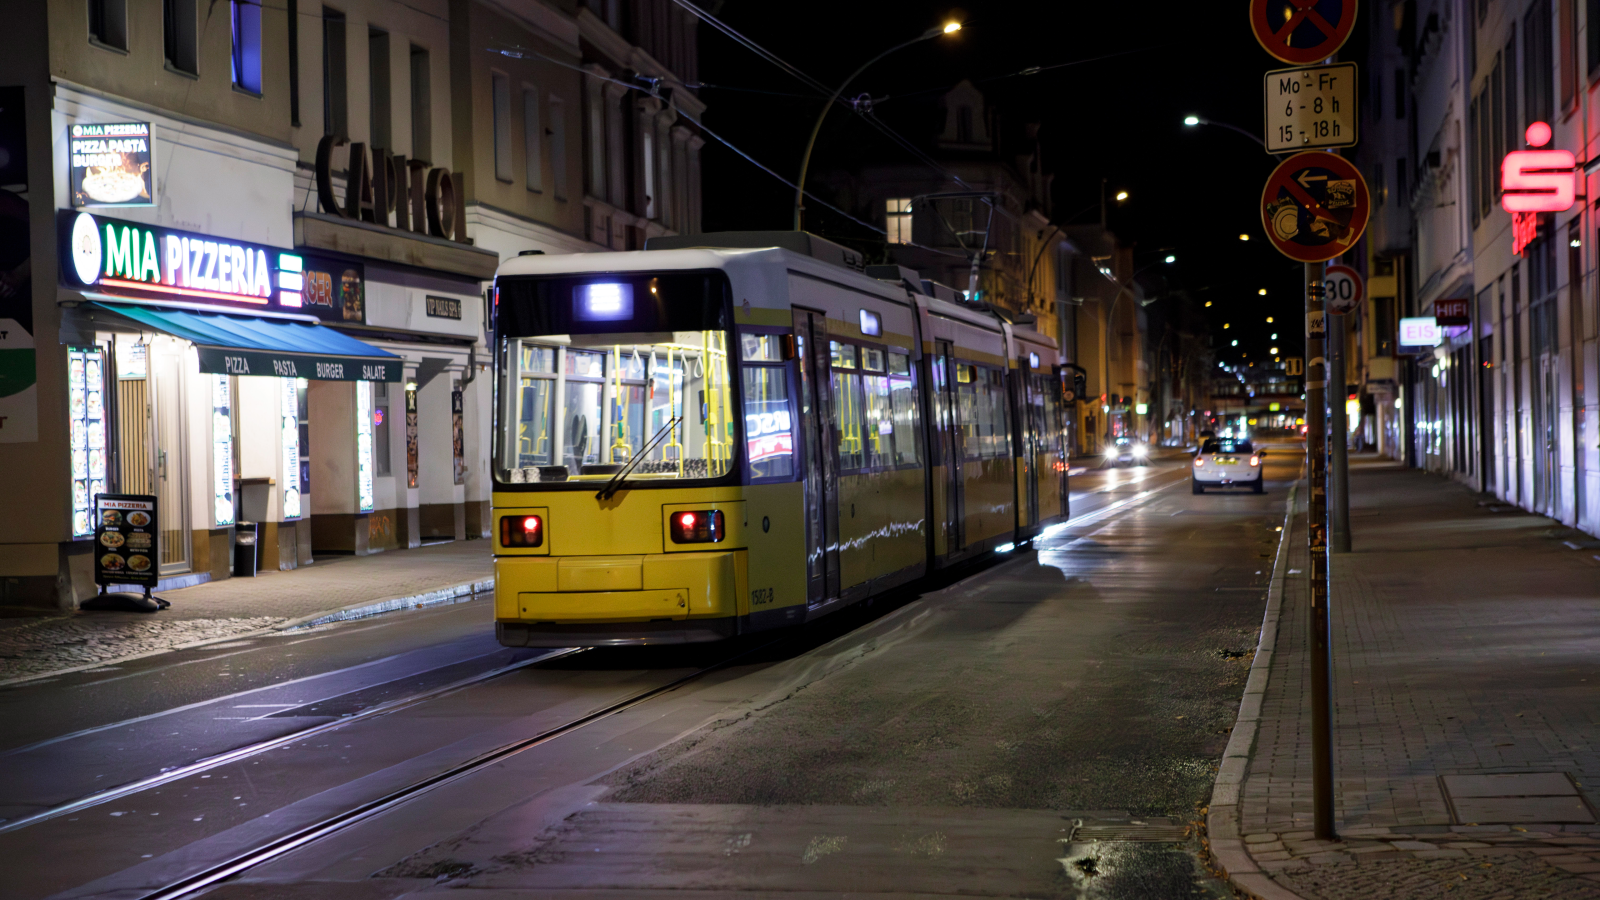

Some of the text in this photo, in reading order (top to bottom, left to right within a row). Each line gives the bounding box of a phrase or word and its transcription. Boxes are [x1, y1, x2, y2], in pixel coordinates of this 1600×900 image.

[1280, 77, 1300, 95] Mo
[1318, 73, 1337, 91] Fr
[1285, 100, 1293, 117] 6
[1313, 97, 1323, 114] 8
[1332, 96, 1340, 113] h
[83, 123, 149, 136] MIA PIZZERIA
[1279, 125, 1293, 142] 15
[1313, 120, 1329, 138] 18
[1333, 120, 1340, 137] h
[72, 139, 147, 153] PIZZA PASTA
[73, 153, 123, 168] BURGER
[315, 134, 474, 245] CAPITOL
[105, 223, 161, 283] MIA
[166, 235, 271, 298] PIZZERIA
[1325, 278, 1352, 300] 30
[1436, 302, 1468, 317] HIFI
[1406, 325, 1434, 339] EIS
[224, 356, 386, 380] PIZZA PASTA BURGER SALATE
